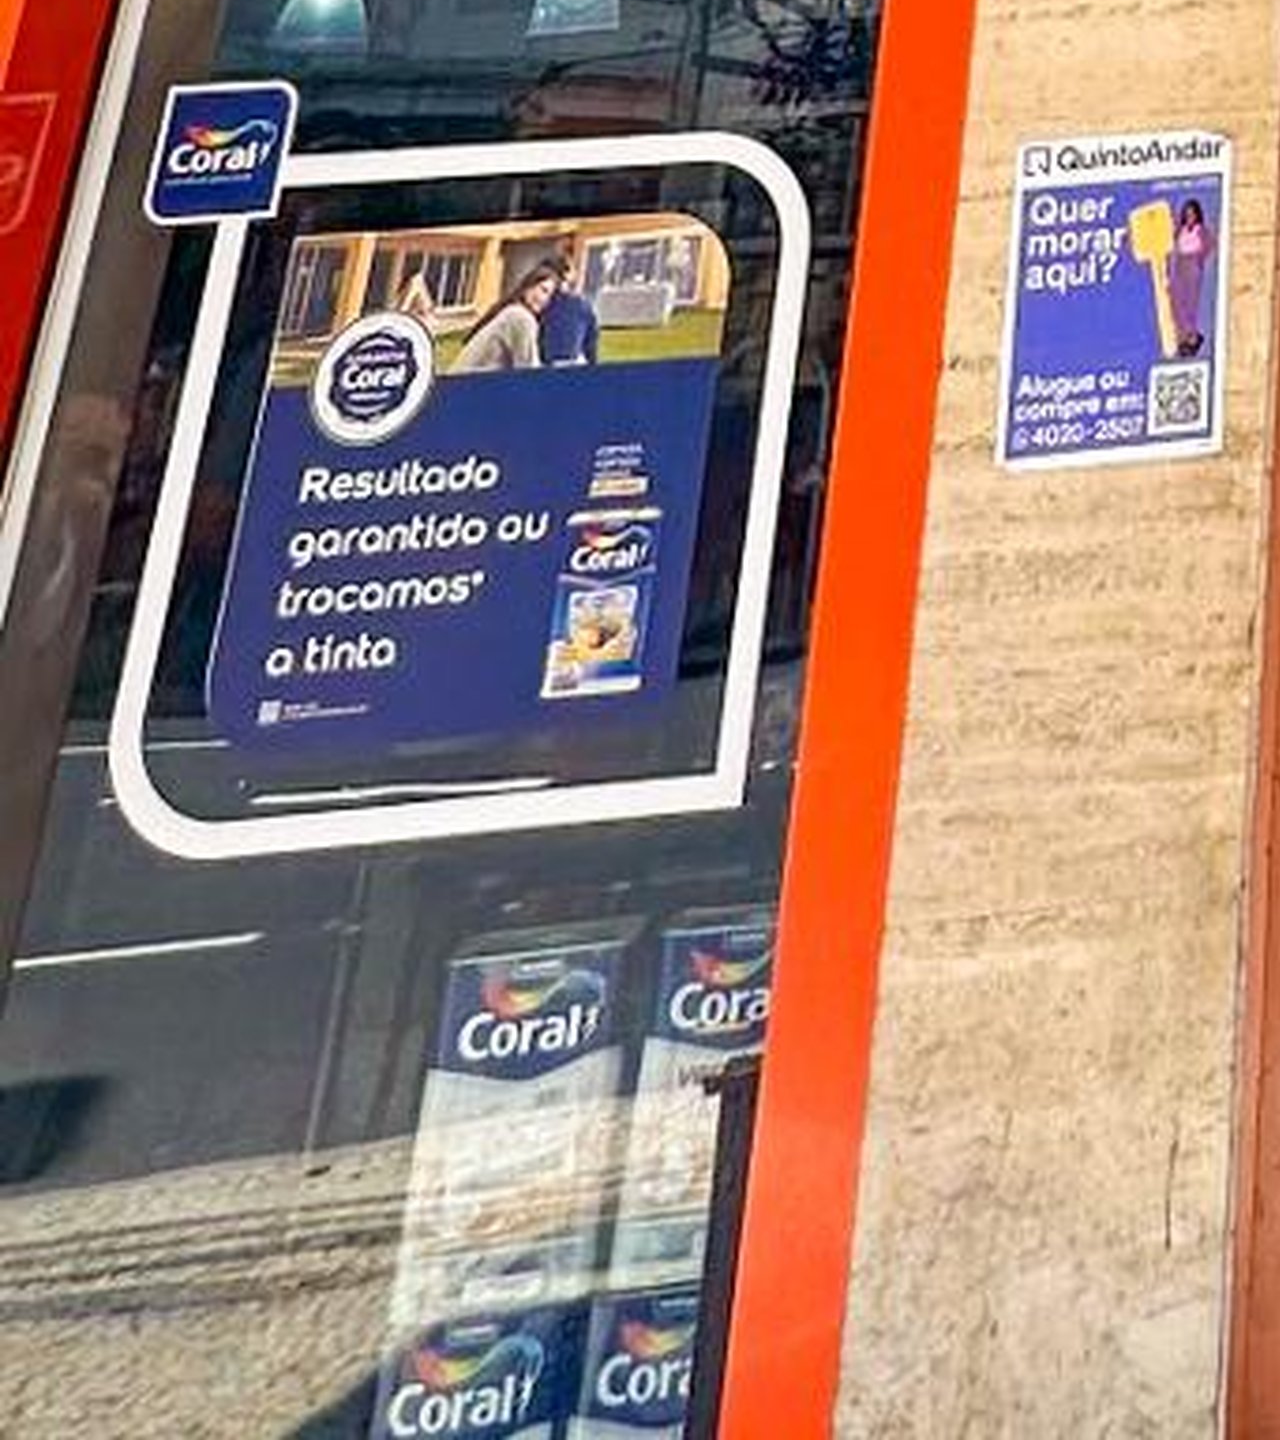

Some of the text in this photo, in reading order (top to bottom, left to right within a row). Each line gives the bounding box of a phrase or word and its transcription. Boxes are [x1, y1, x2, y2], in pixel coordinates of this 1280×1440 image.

[168, 138, 261, 173] Coral
[1056, 139, 1225, 172] QuintoAndar
[1029, 193, 1115, 227] Quer
[1027, 227, 1127, 258] morar
[1024, 253, 1118, 296] aqui?
[341, 365, 406, 389] Coral
[300, 456, 499, 503] Resultado
[288, 511, 550, 569] garantido ou
[570, 543, 640, 571] Coral
[265, 631, 397, 678] a tinta
[669, 982, 773, 1031] Cora
[457, 1003, 583, 1060] Coral
[386, 1373, 518, 1437] Coral
